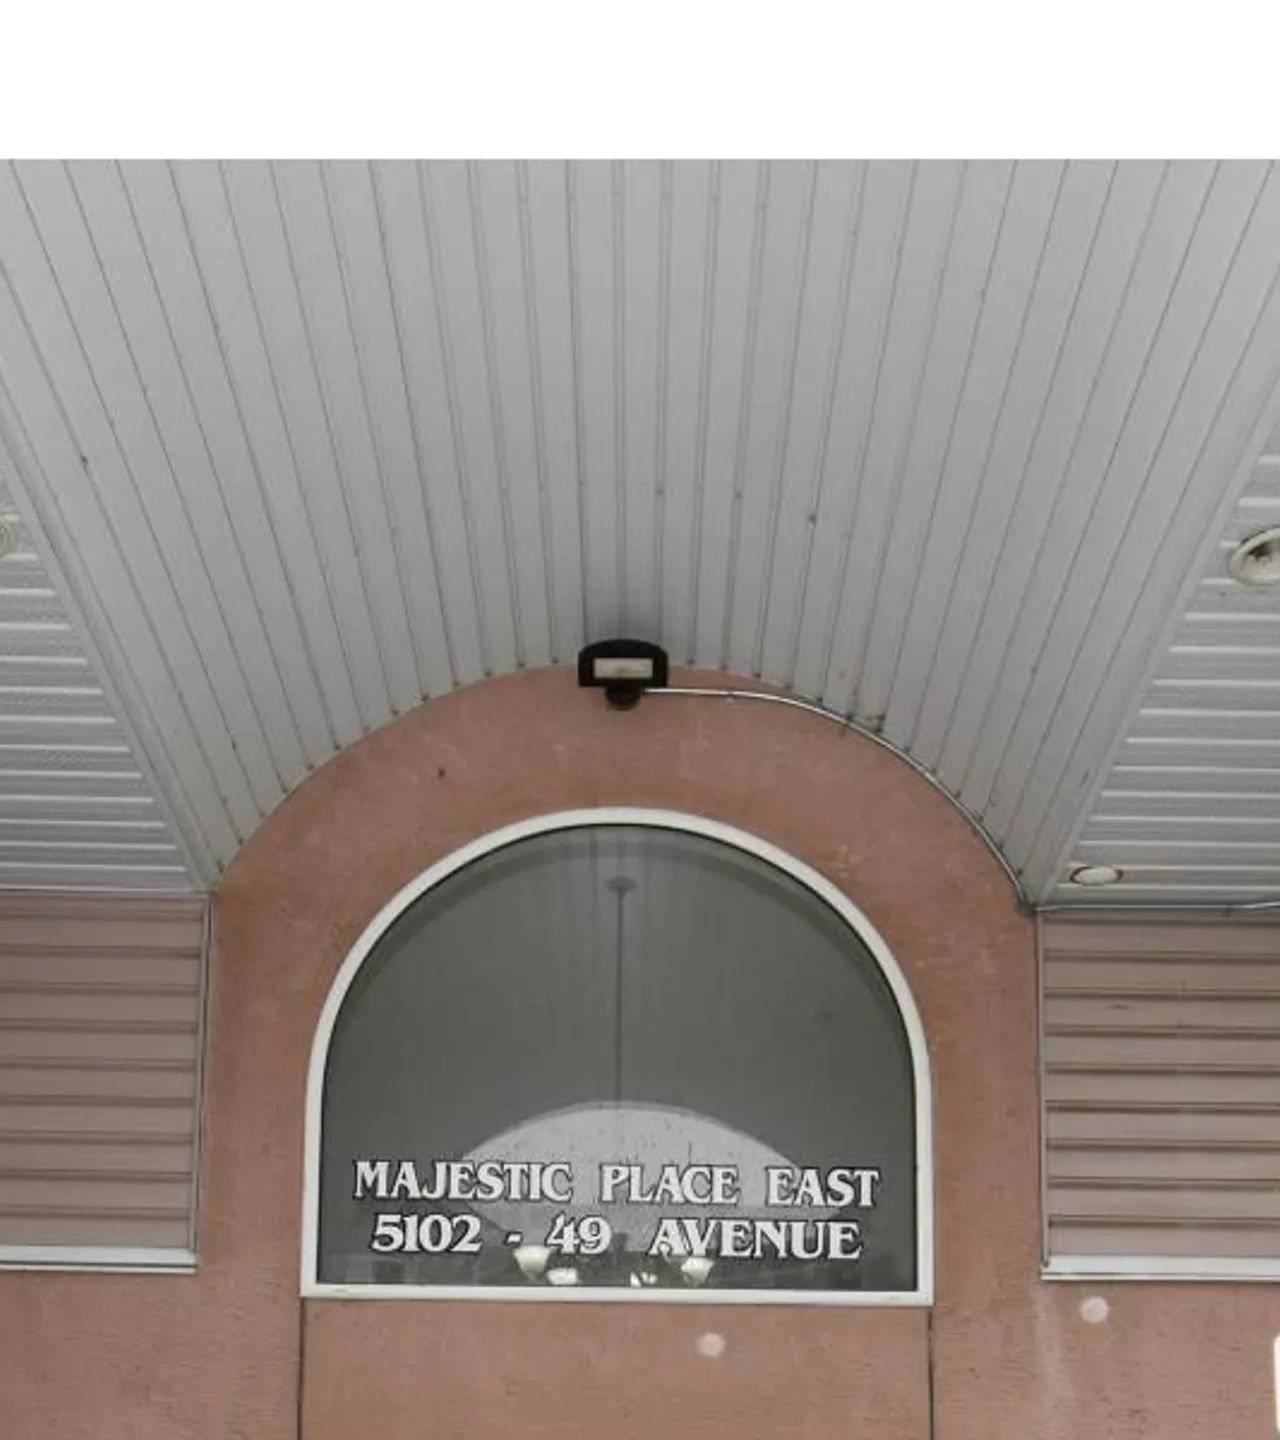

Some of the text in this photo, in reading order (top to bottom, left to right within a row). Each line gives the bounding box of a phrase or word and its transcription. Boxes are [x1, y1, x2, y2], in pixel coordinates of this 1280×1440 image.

[354, 1159, 880, 1208] MAJESTIC PLACE EAST
[371, 1213, 482, 1253] 5102
[546, 1214, 612, 1255] 49
[648, 1218, 863, 1260] AVENUE
